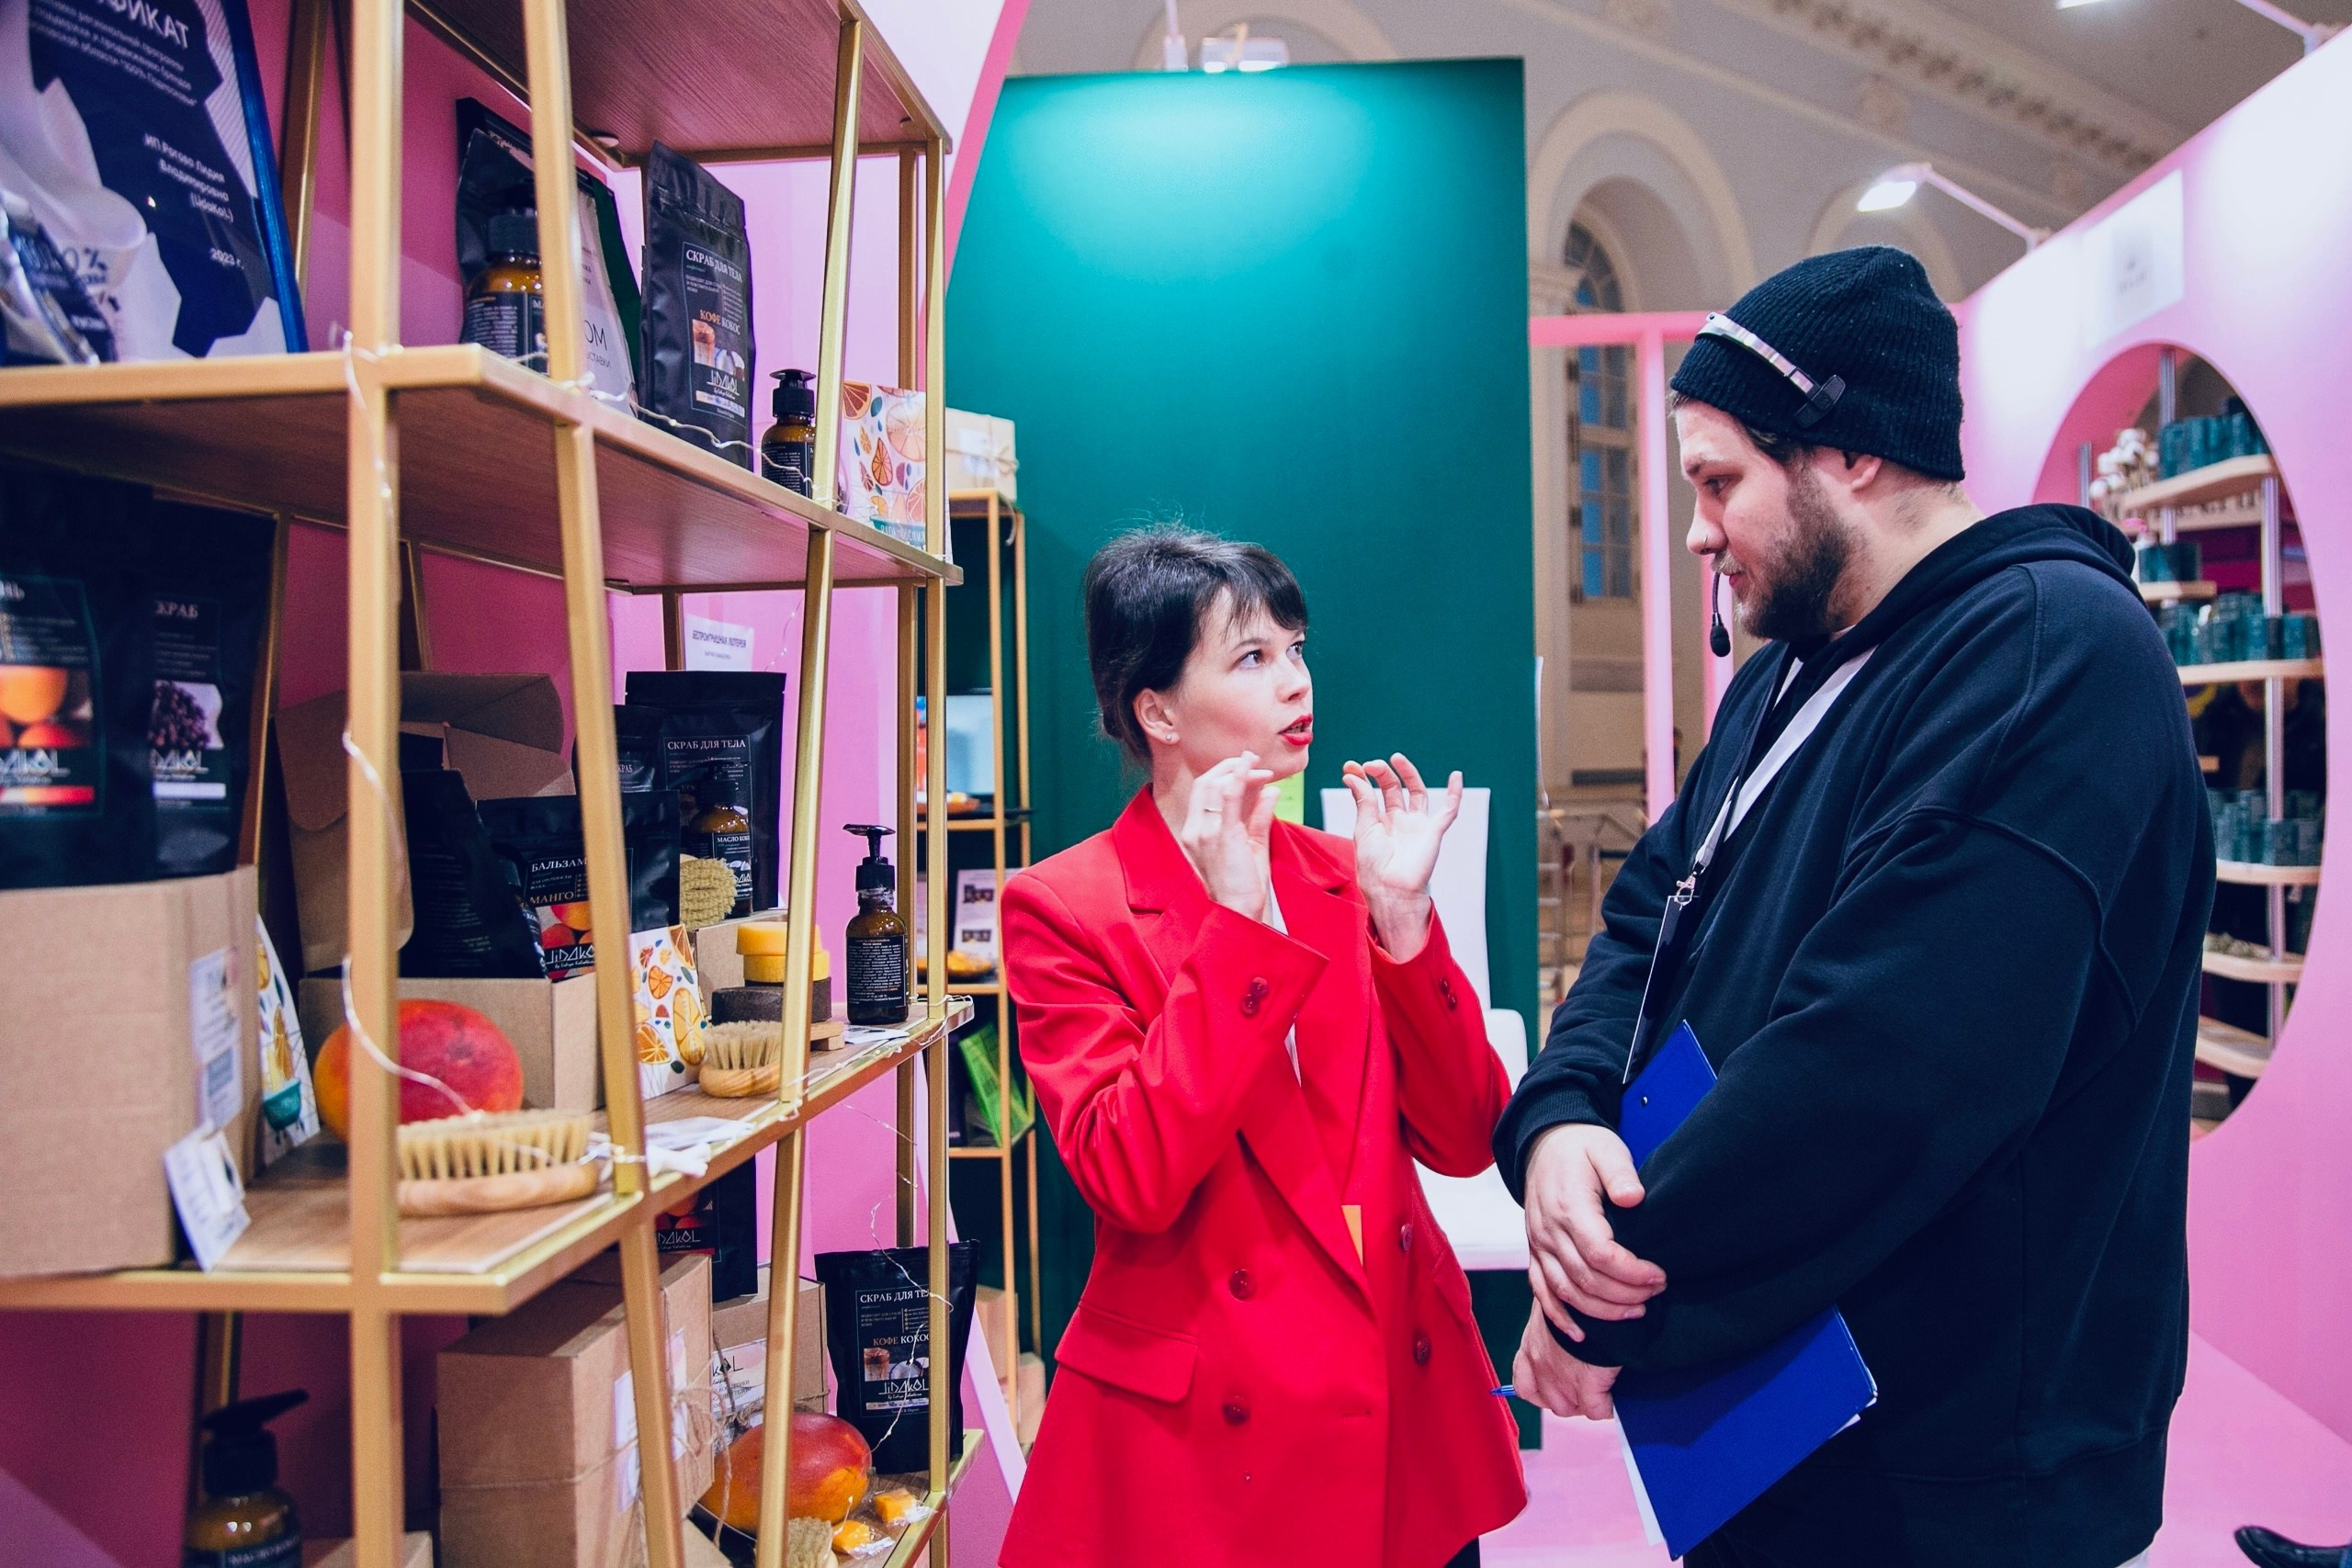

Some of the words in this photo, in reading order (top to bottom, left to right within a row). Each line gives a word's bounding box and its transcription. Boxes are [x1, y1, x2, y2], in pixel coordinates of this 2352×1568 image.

[686, 249, 714, 268] СКРАБ
[714, 260, 728, 275] ДЛЯ
[728, 265, 742, 284] ТЕЛА
[700, 310, 721, 325] КОФЕ
[721, 317, 741, 334] КОКОС
[586, 353, 611, 368] СТАВКИ
[667, 740, 698, 750] СКРАБ
[700, 739, 719, 750] ДЛЯ
[721, 739, 746, 748] ТЕЛА
[617, 764, 633, 773] КРАБ
[532, 858, 587, 873] БАЛЬЗАМ
[529, 891, 574, 905] МАНГО
[860, 1293, 891, 1303] СКРАБ
[893, 1291, 913, 1303] ДЛЯ
[914, 1288, 929, 1299] ТЕЛ
[873, 1337, 899, 1348] КОФЕ
